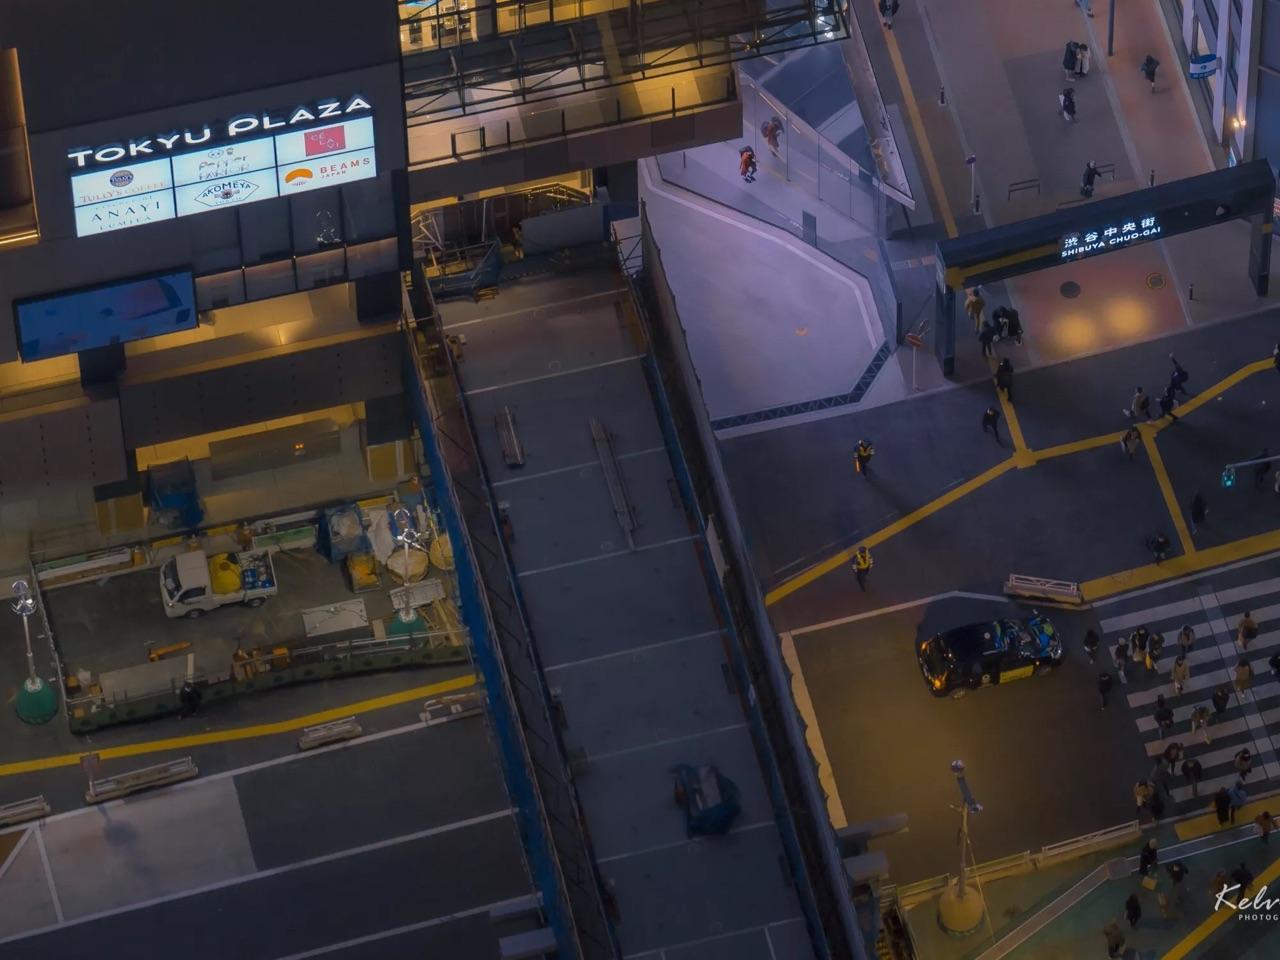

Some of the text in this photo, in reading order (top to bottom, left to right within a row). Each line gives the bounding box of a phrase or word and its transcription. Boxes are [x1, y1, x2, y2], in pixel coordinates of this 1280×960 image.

[67, 98, 372, 167] TOKYU PLAZA
[320, 157, 370, 174] BEAMS
[202, 181, 252, 198] AKOMEYA
[91, 201, 160, 223] ANAYI
[1061, 226, 1161, 257] SHIBUYA CHUO-GAI
[1064, 216, 1156, 248] 渋谷中央街
